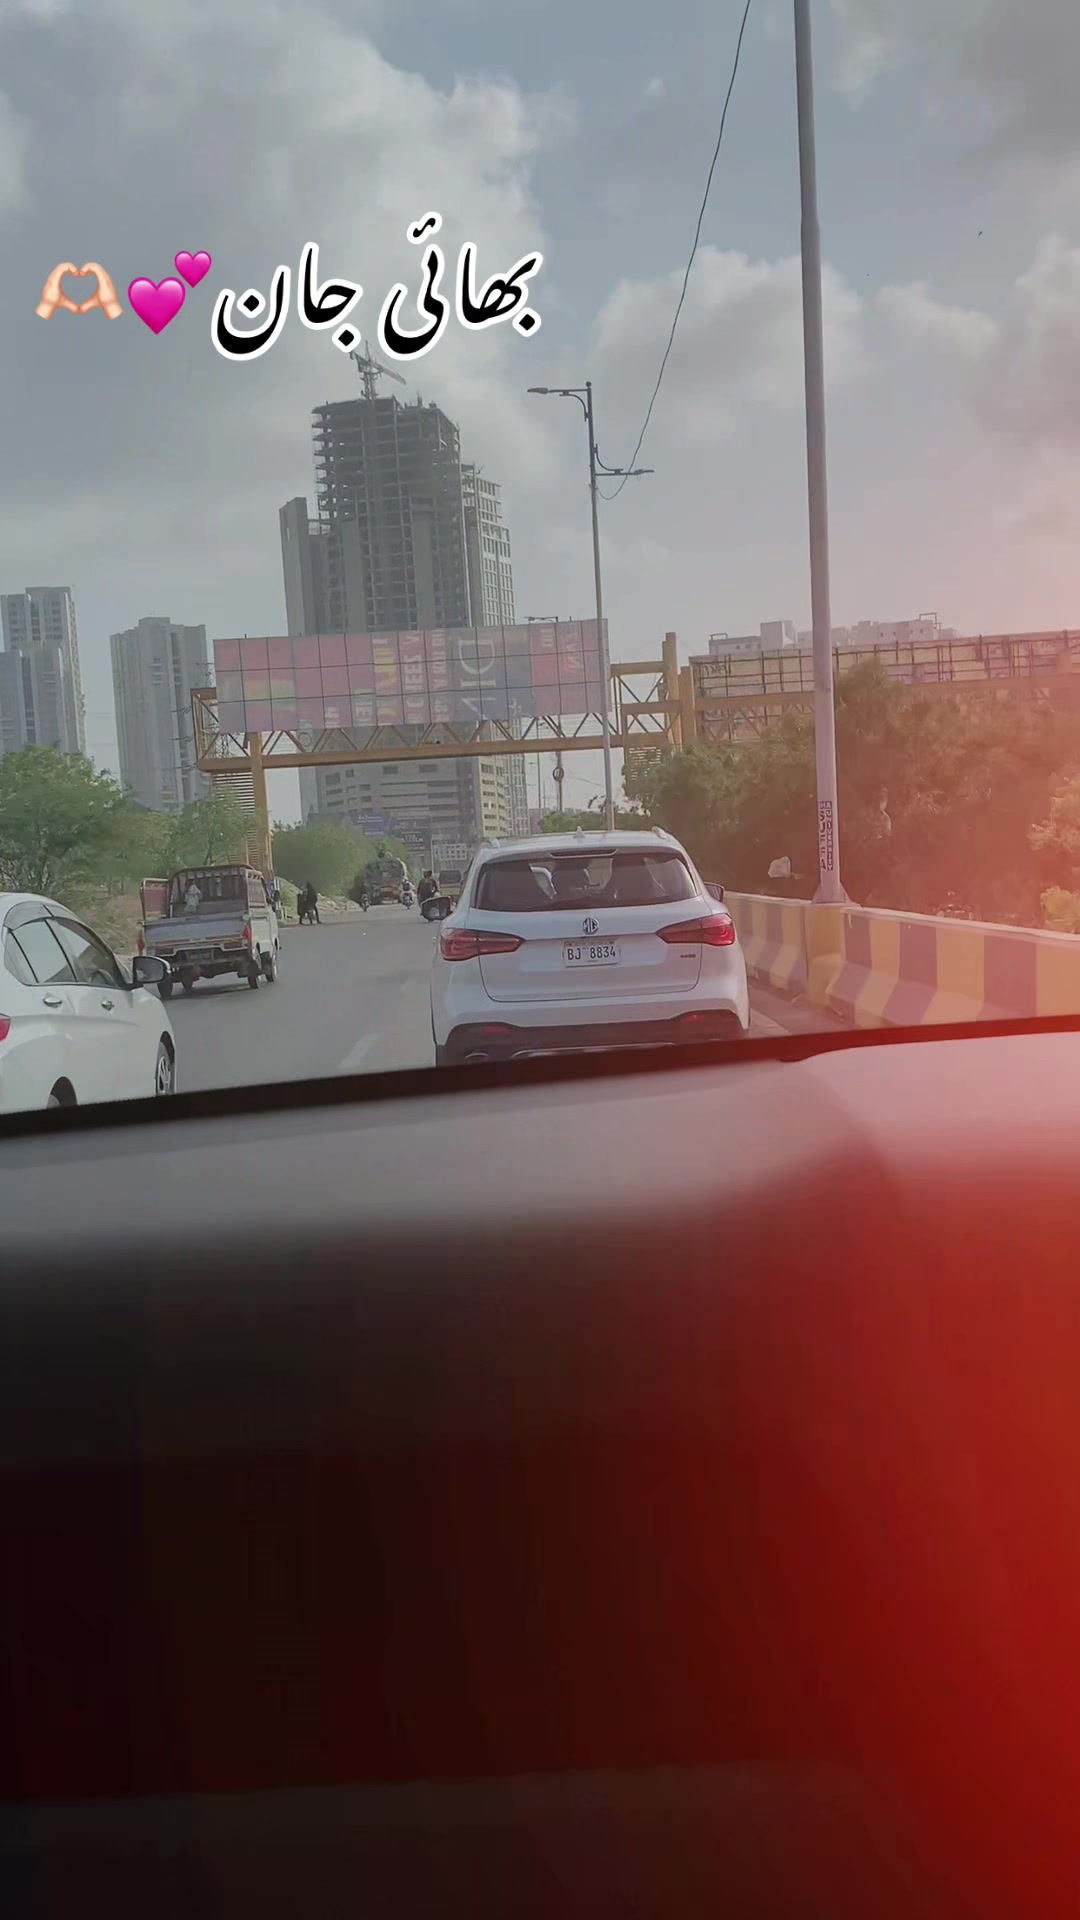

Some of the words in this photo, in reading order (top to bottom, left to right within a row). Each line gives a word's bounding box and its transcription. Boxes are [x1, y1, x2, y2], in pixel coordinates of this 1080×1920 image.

[582, 917, 599, 935] MG
[567, 948, 581, 960] BJ
[590, 945, 616, 959] 8834
